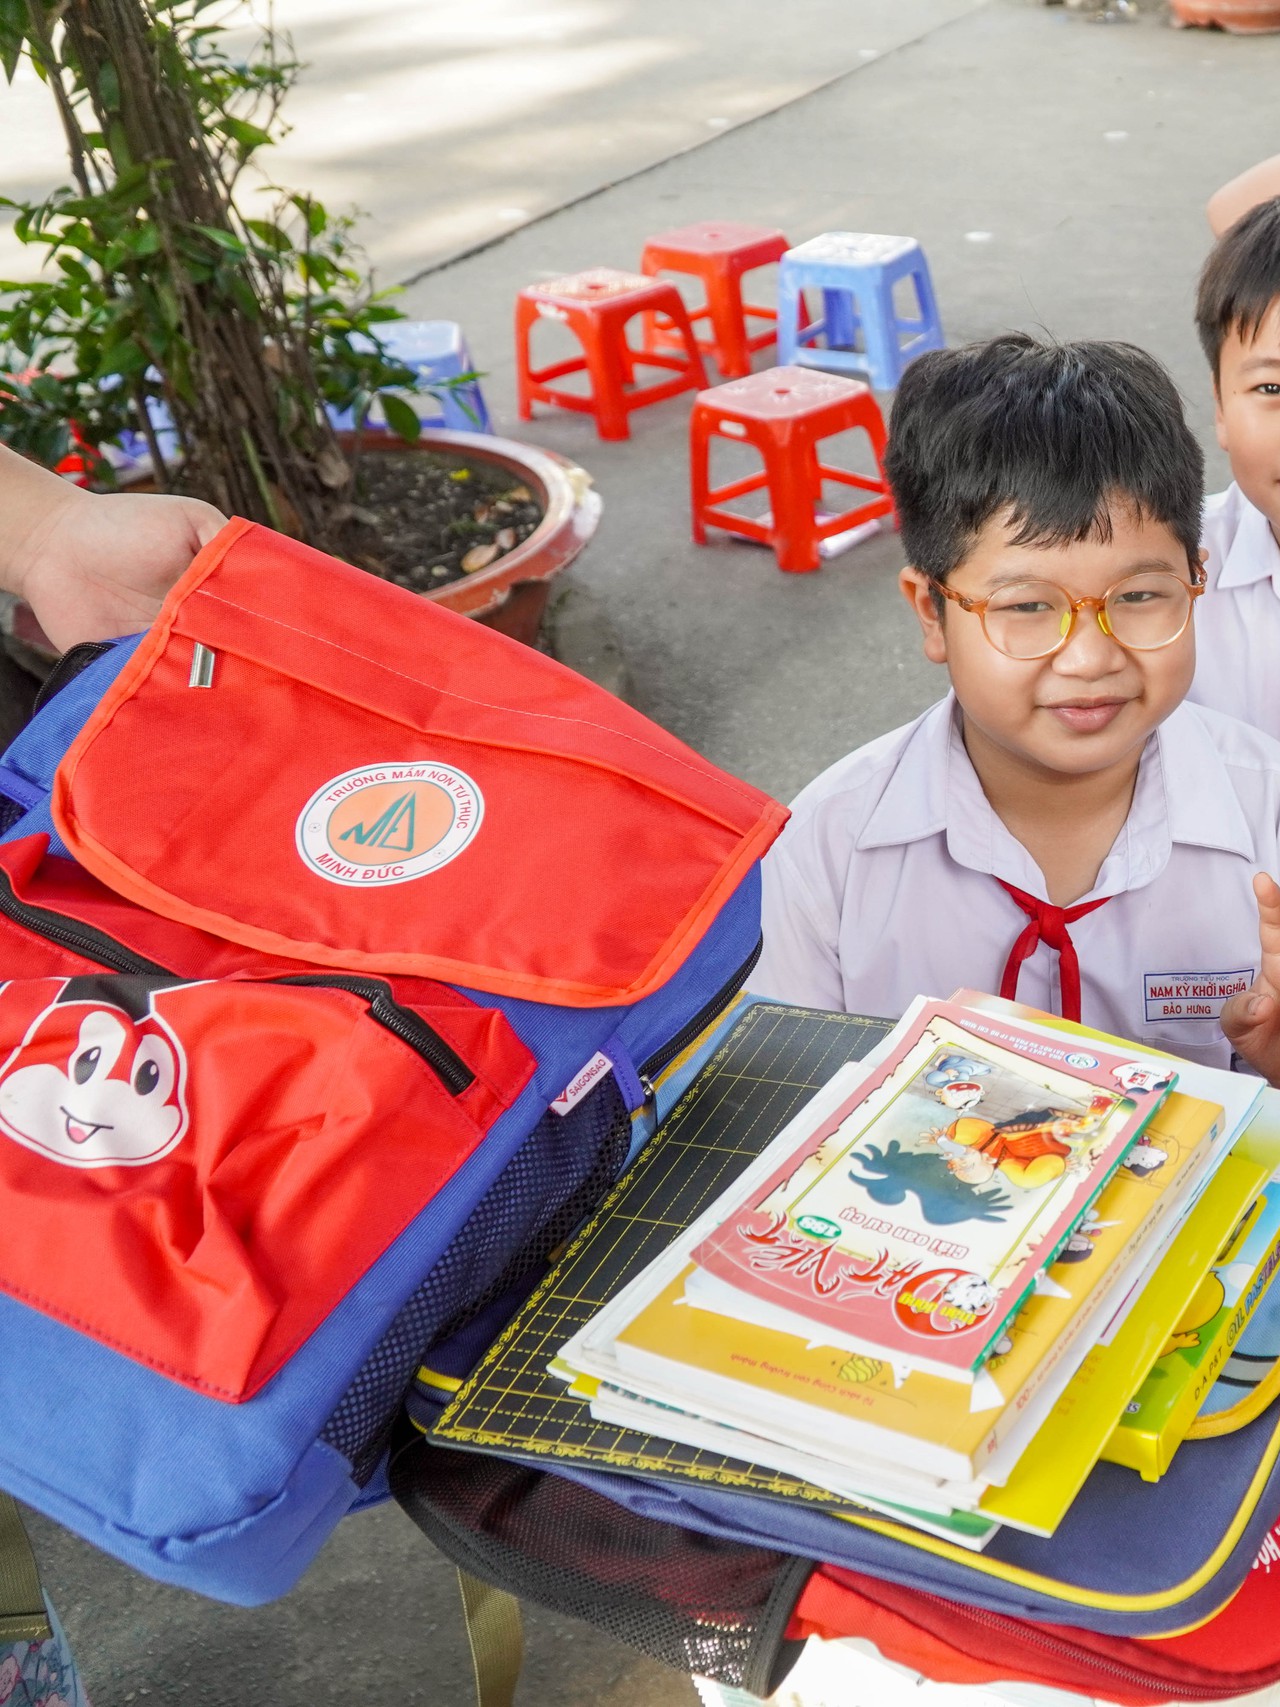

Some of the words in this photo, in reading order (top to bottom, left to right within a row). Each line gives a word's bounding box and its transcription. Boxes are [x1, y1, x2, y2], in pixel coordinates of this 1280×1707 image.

[325, 772, 387, 803] TRƯỜNG
[427, 770, 456, 786] NON
[453, 784, 470, 799] TƯ
[457, 799, 472, 830] THỤC
[315, 853, 358, 878] MINH
[362, 865, 405, 880] ĐỨC
[1150, 986, 1173, 998] NAM
[1176, 982, 1190, 997] KỲ
[1192, 981, 1216, 997] KHỞI
[1219, 978, 1247, 996] NGHĨA
[1163, 1002, 1182, 1015] BẢO
[1186, 1005, 1211, 1014] HƯNG
[569, 1059, 606, 1096] SAIGONSAO
[838, 1206, 864, 1225] cụ
[862, 1216, 893, 1235] sư
[893, 1226, 929, 1248] oan
[928, 1238, 970, 1260] Giải
[1226, 1308, 1245, 1348] OIL
